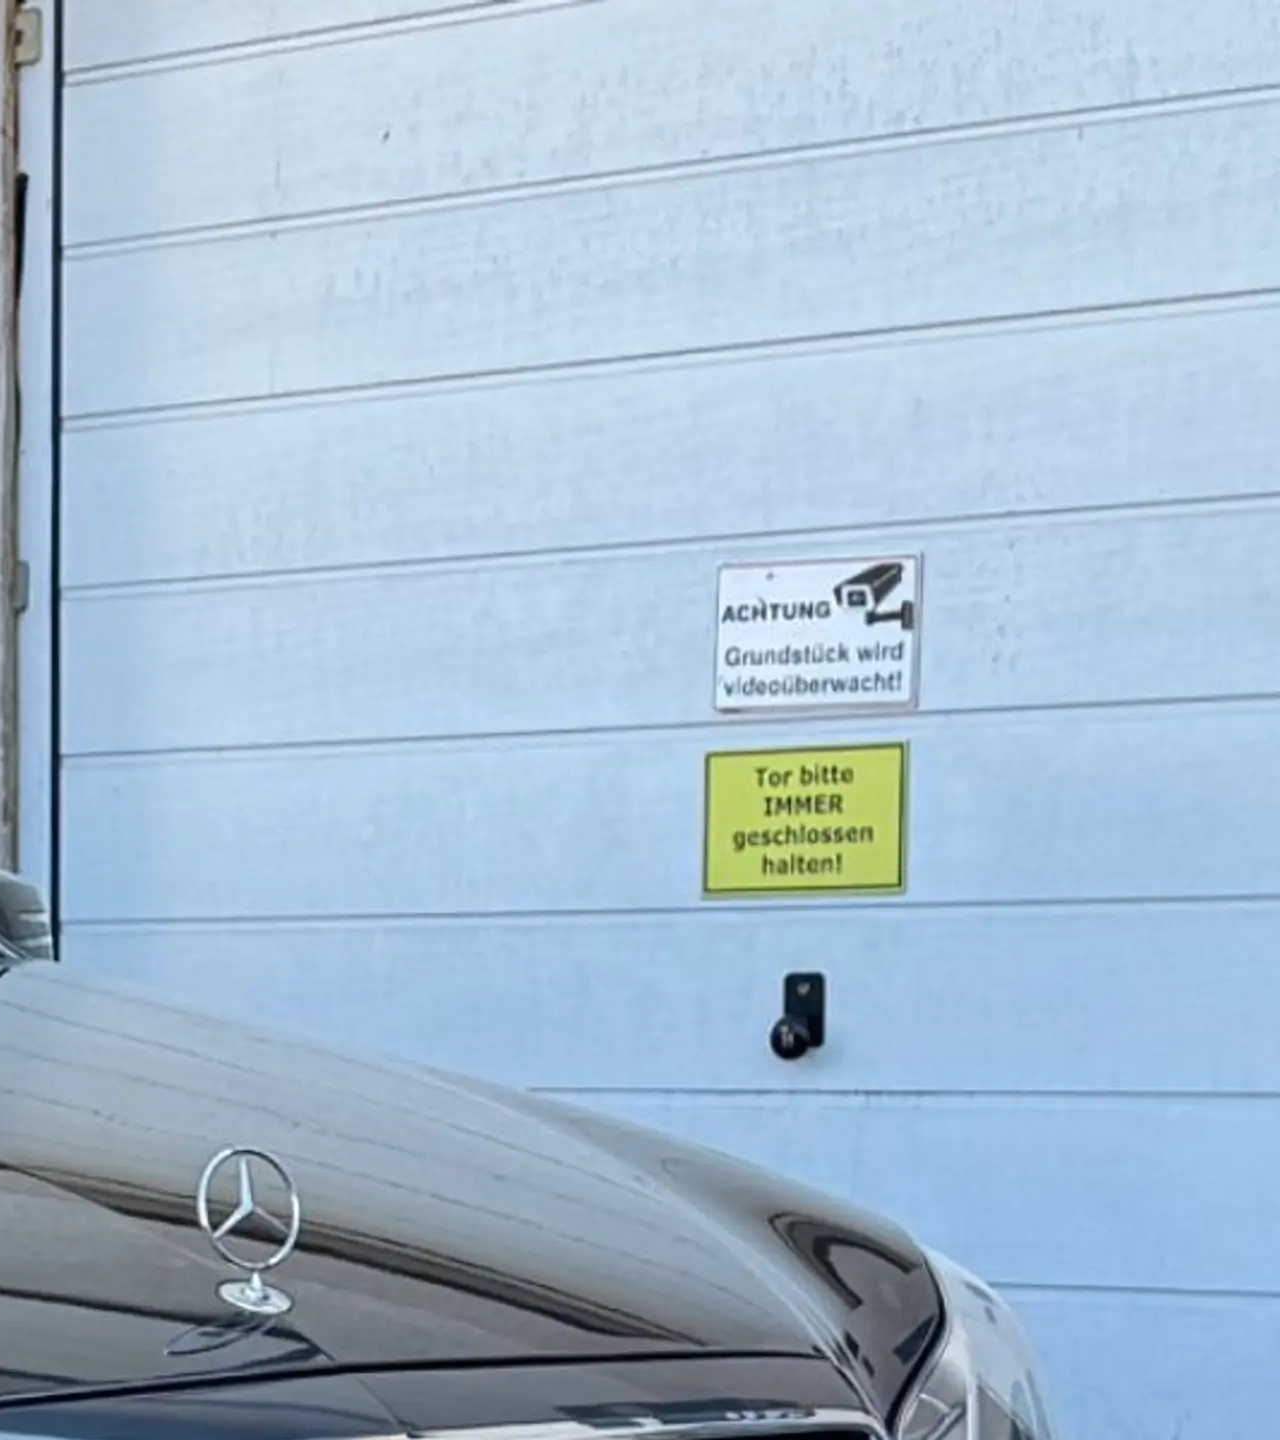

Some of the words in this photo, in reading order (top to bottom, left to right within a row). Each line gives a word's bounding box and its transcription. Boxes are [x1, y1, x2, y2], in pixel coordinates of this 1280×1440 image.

[721, 600, 831, 623] ACHTUNG
[724, 642, 850, 667] Grundstück
[857, 641, 905, 662] wird
[723, 670, 902, 696] videoüberwacht!
[755, 767, 793, 788] Tor
[800, 764, 854, 786] bitte
[764, 794, 844, 817] IMMER
[732, 824, 875, 853] geschlossen
[762, 853, 843, 876] halten!
